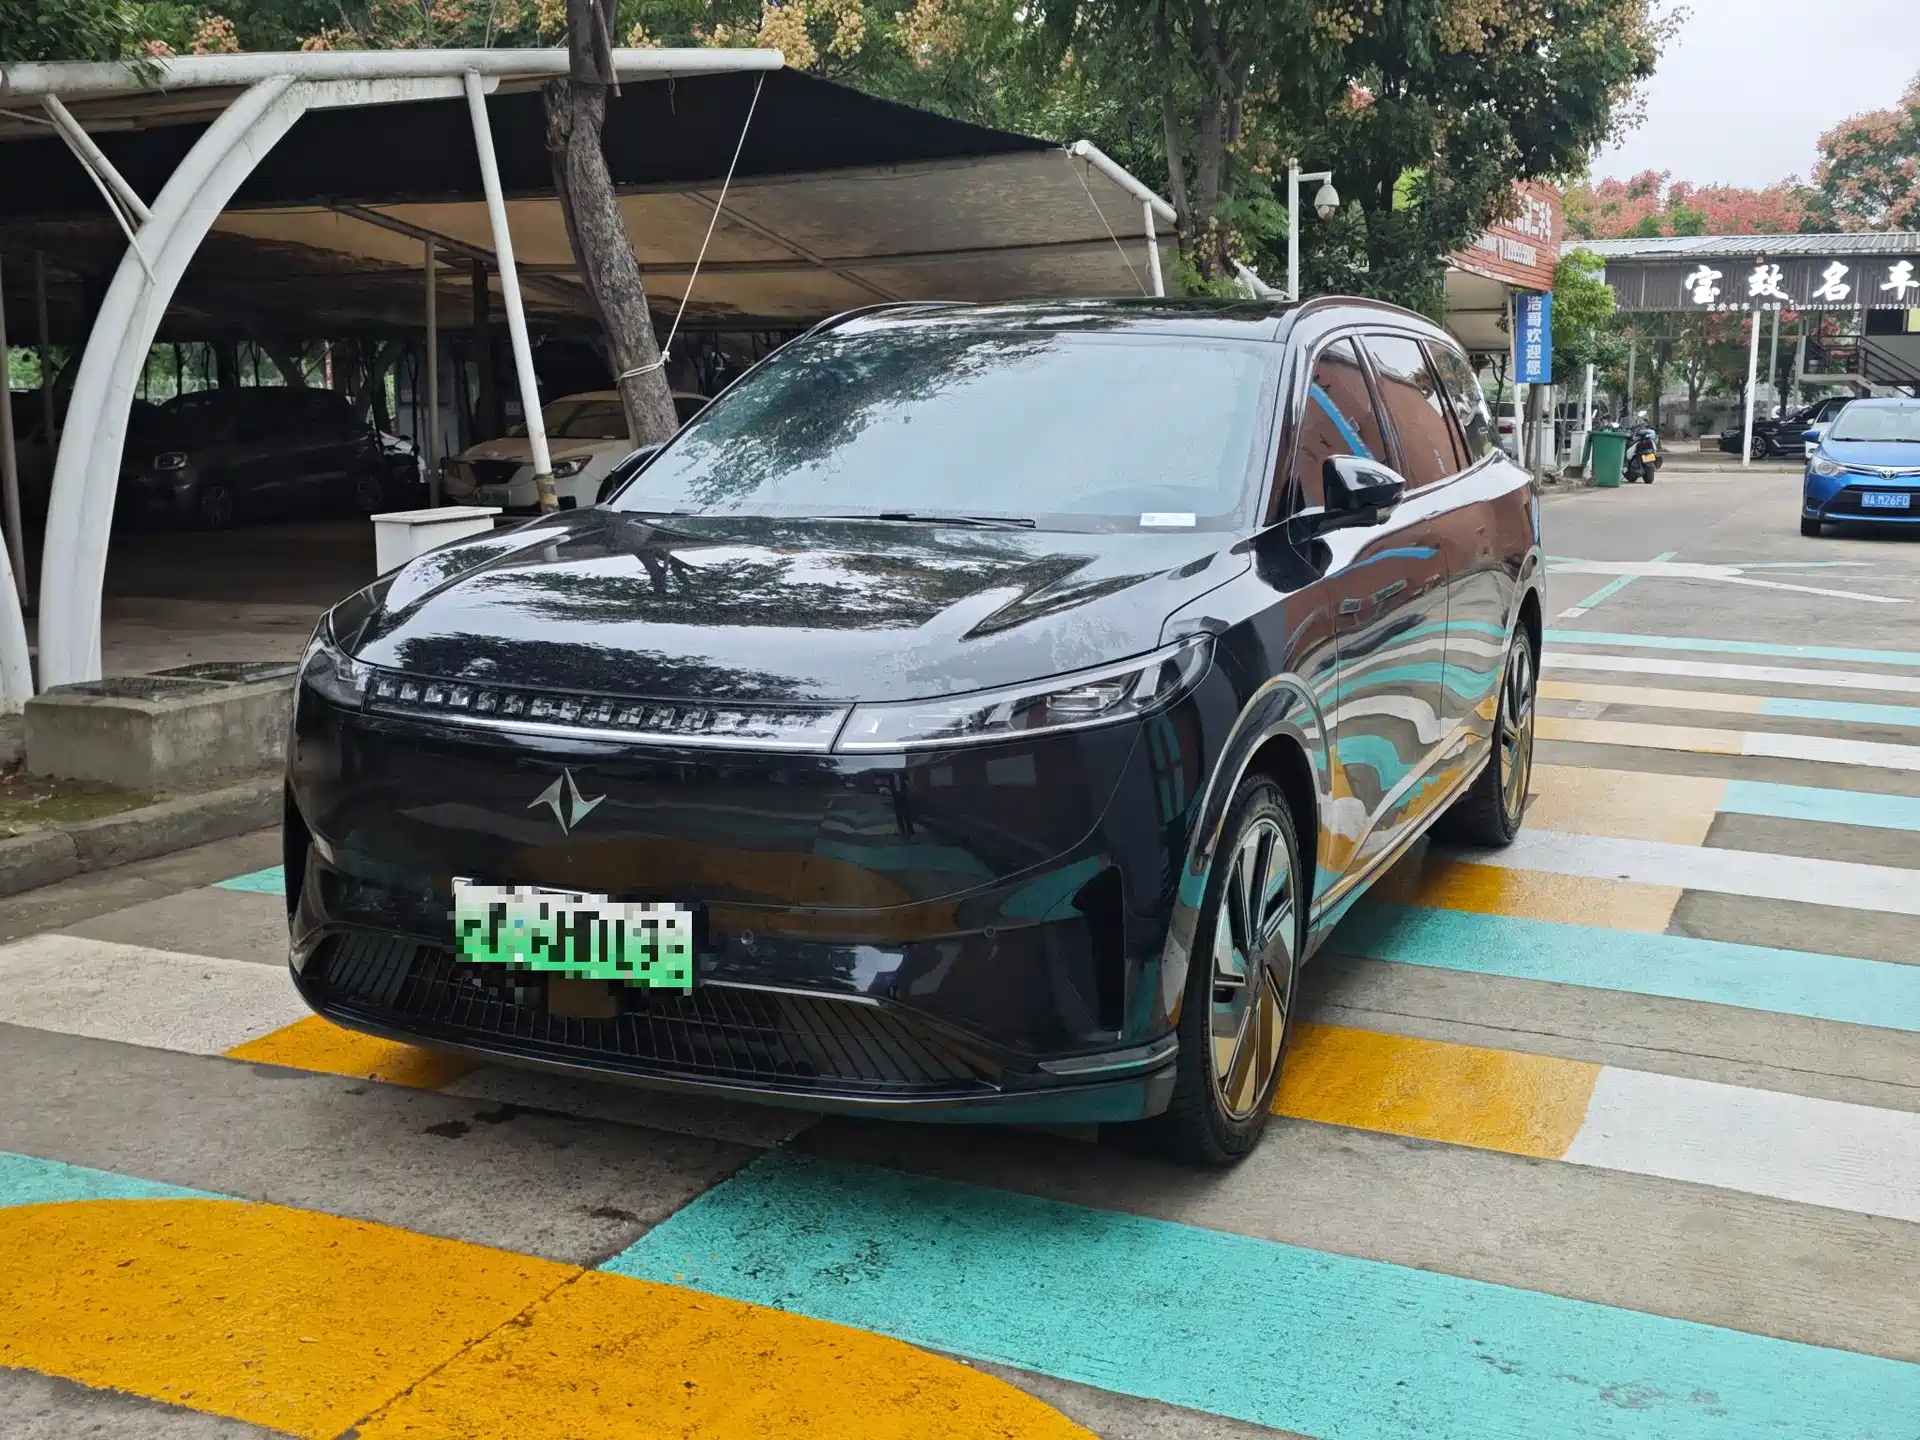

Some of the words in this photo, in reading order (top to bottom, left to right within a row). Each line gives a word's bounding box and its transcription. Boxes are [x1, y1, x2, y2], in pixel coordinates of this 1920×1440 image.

[1685, 260, 1920, 303] 宝致名车
[1526, 296, 1542, 376] 浩哥欢迎您
